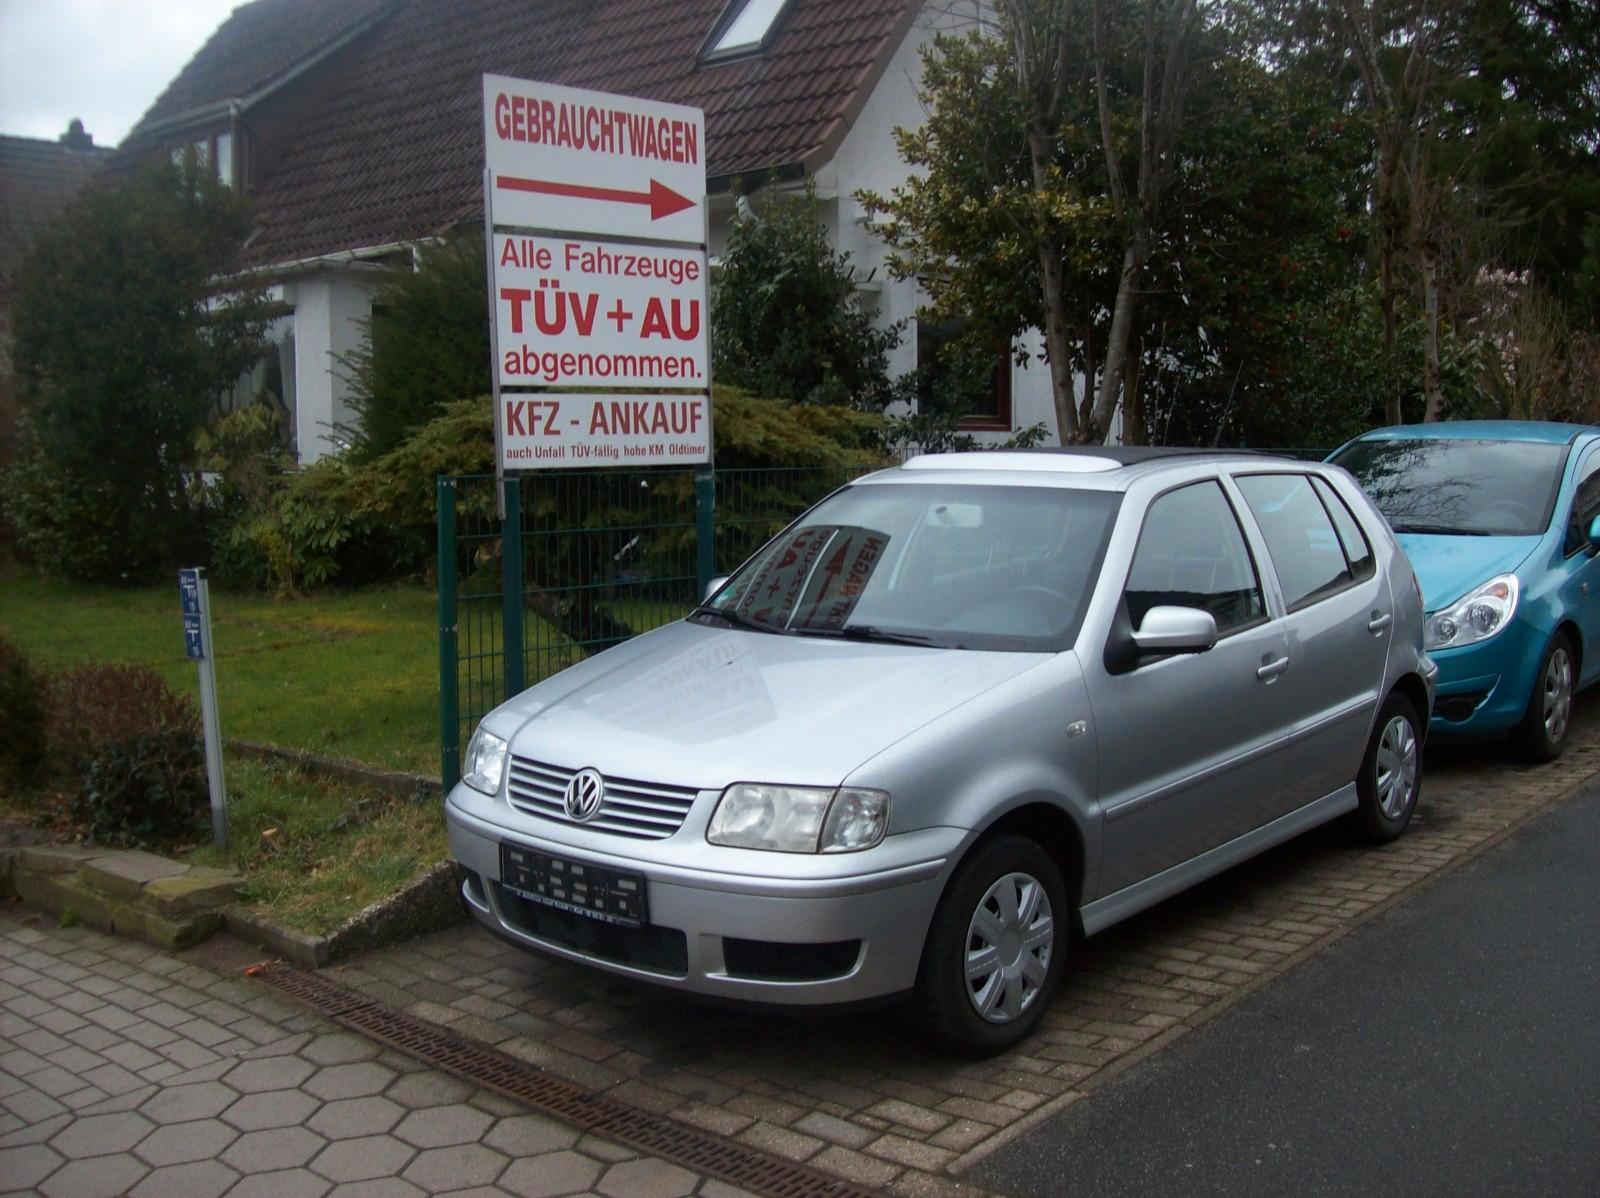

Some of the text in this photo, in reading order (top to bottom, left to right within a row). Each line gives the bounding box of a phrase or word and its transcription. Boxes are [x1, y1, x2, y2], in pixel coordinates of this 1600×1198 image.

[496, 93, 697, 164] GEBRAUCHTWAGEN
[500, 239, 699, 284] Alle Fahrzeuge
[501, 279, 599, 336] TÜV
[640, 298, 699, 340] AU
[505, 345, 702, 381] abgenommen.
[506, 401, 561, 436] KFZ
[590, 402, 702, 435] ANKAUF
[507, 444, 705, 459] auch Unfall TÜV-fällig hohe KM Oldtimer
